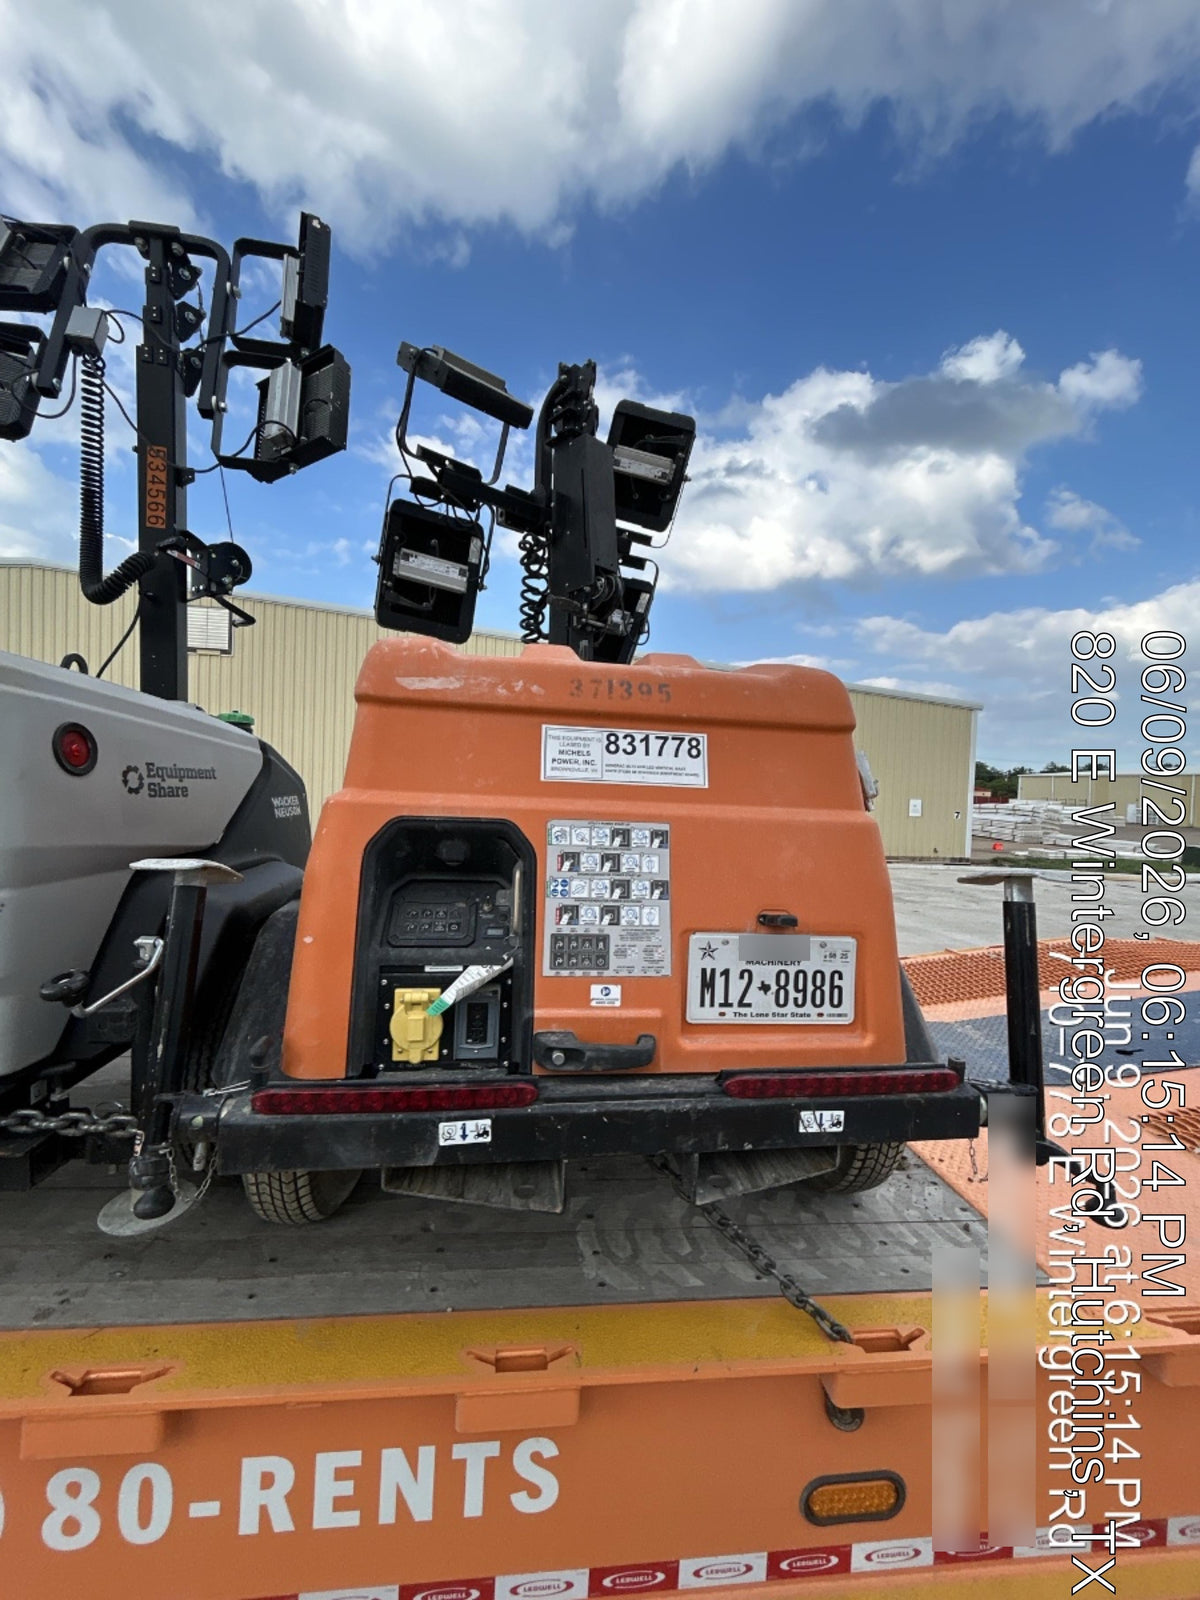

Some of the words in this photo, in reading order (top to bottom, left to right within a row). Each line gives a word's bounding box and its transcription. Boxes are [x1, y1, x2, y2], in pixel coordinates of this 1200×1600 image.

[148, 447, 167, 527] 534566
[605, 733, 702, 759] 831778
[145, 762, 217, 782] Equipment
[147, 782, 189, 798] Share
[271, 795, 299, 807] WACKER
[274, 806, 302, 818] NEUSON
[699, 968, 753, 1008] M12
[774, 969, 844, 1009] 8986
[41, 1436, 560, 1552] 80-RENTS
[705, 1566, 741, 1576] LEDWELL
[615, 1574, 652, 1584] LEDWELL
[523, 1583, 561, 1593] LEDWELL
[427, 1591, 467, 1600] LEDWELL
